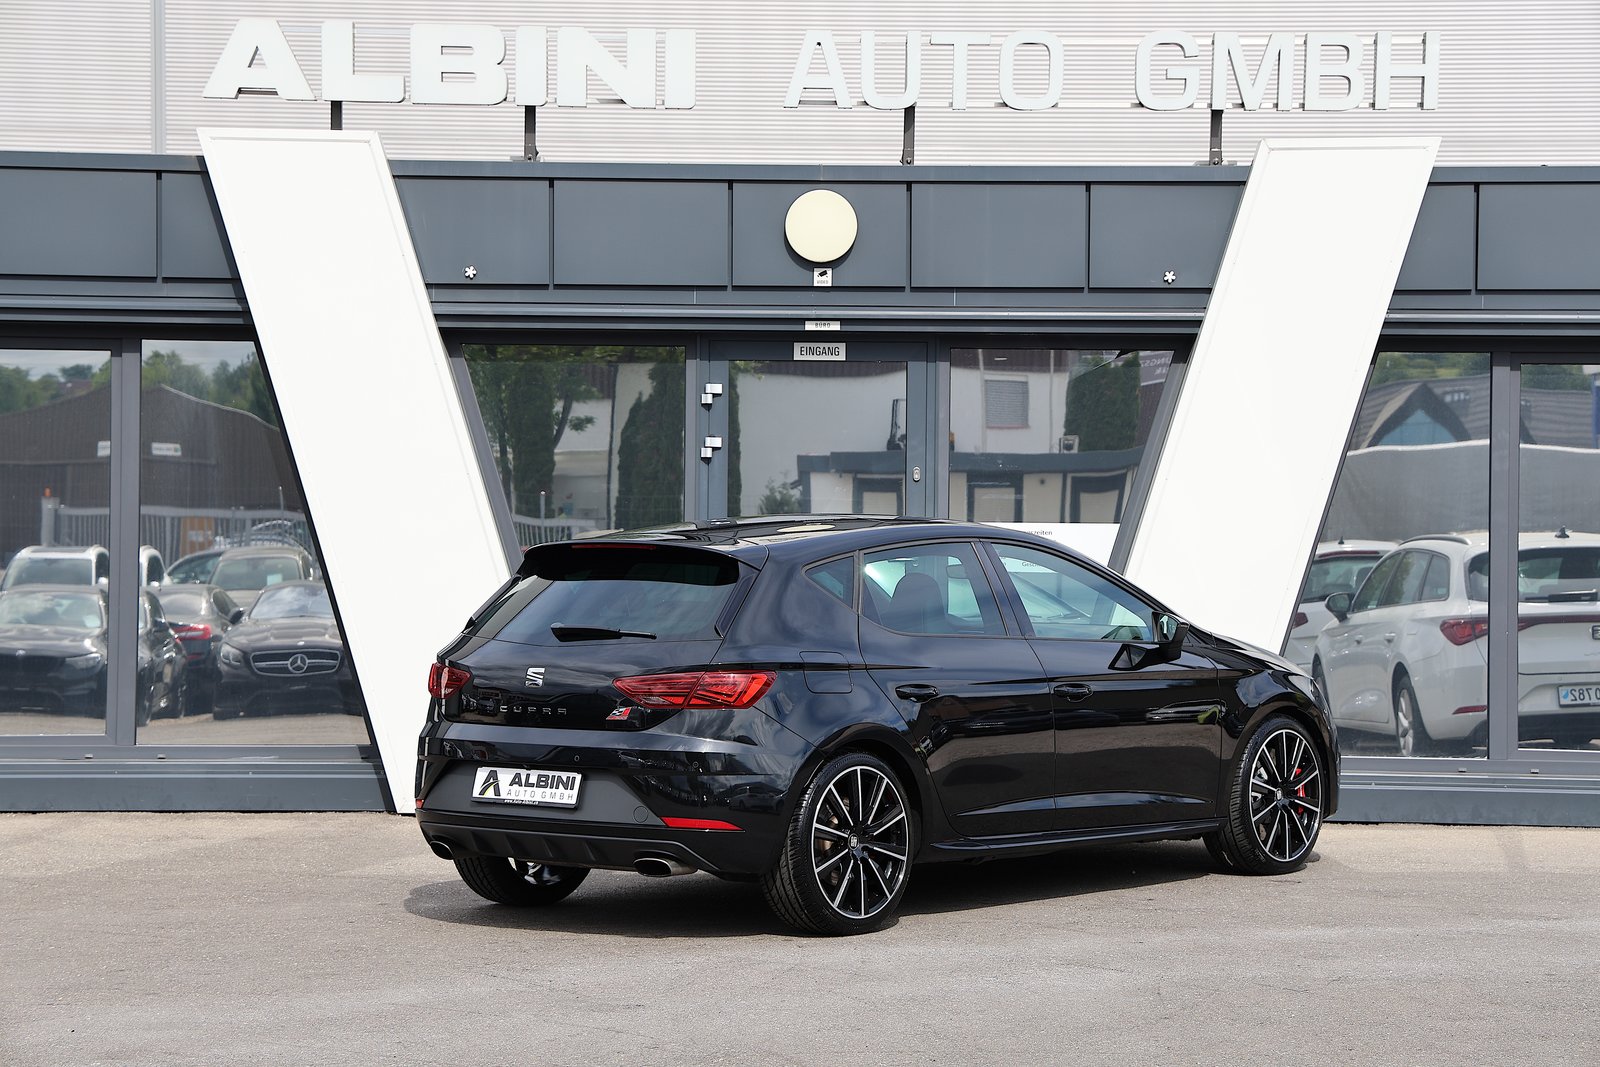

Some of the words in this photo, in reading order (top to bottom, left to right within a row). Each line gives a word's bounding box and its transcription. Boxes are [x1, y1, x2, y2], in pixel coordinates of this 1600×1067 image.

[202, 18, 697, 110] ALBINI
[783, 29, 1064, 111] AUTO
[1134, 30, 1441, 112] GMBH
[799, 346, 840, 356] EINGANG
[499, 705, 567, 715] CUPRA
[508, 772, 577, 791] ALBINI
[506, 789, 536, 799] AUTO
[541, 791, 574, 801] GMBH
